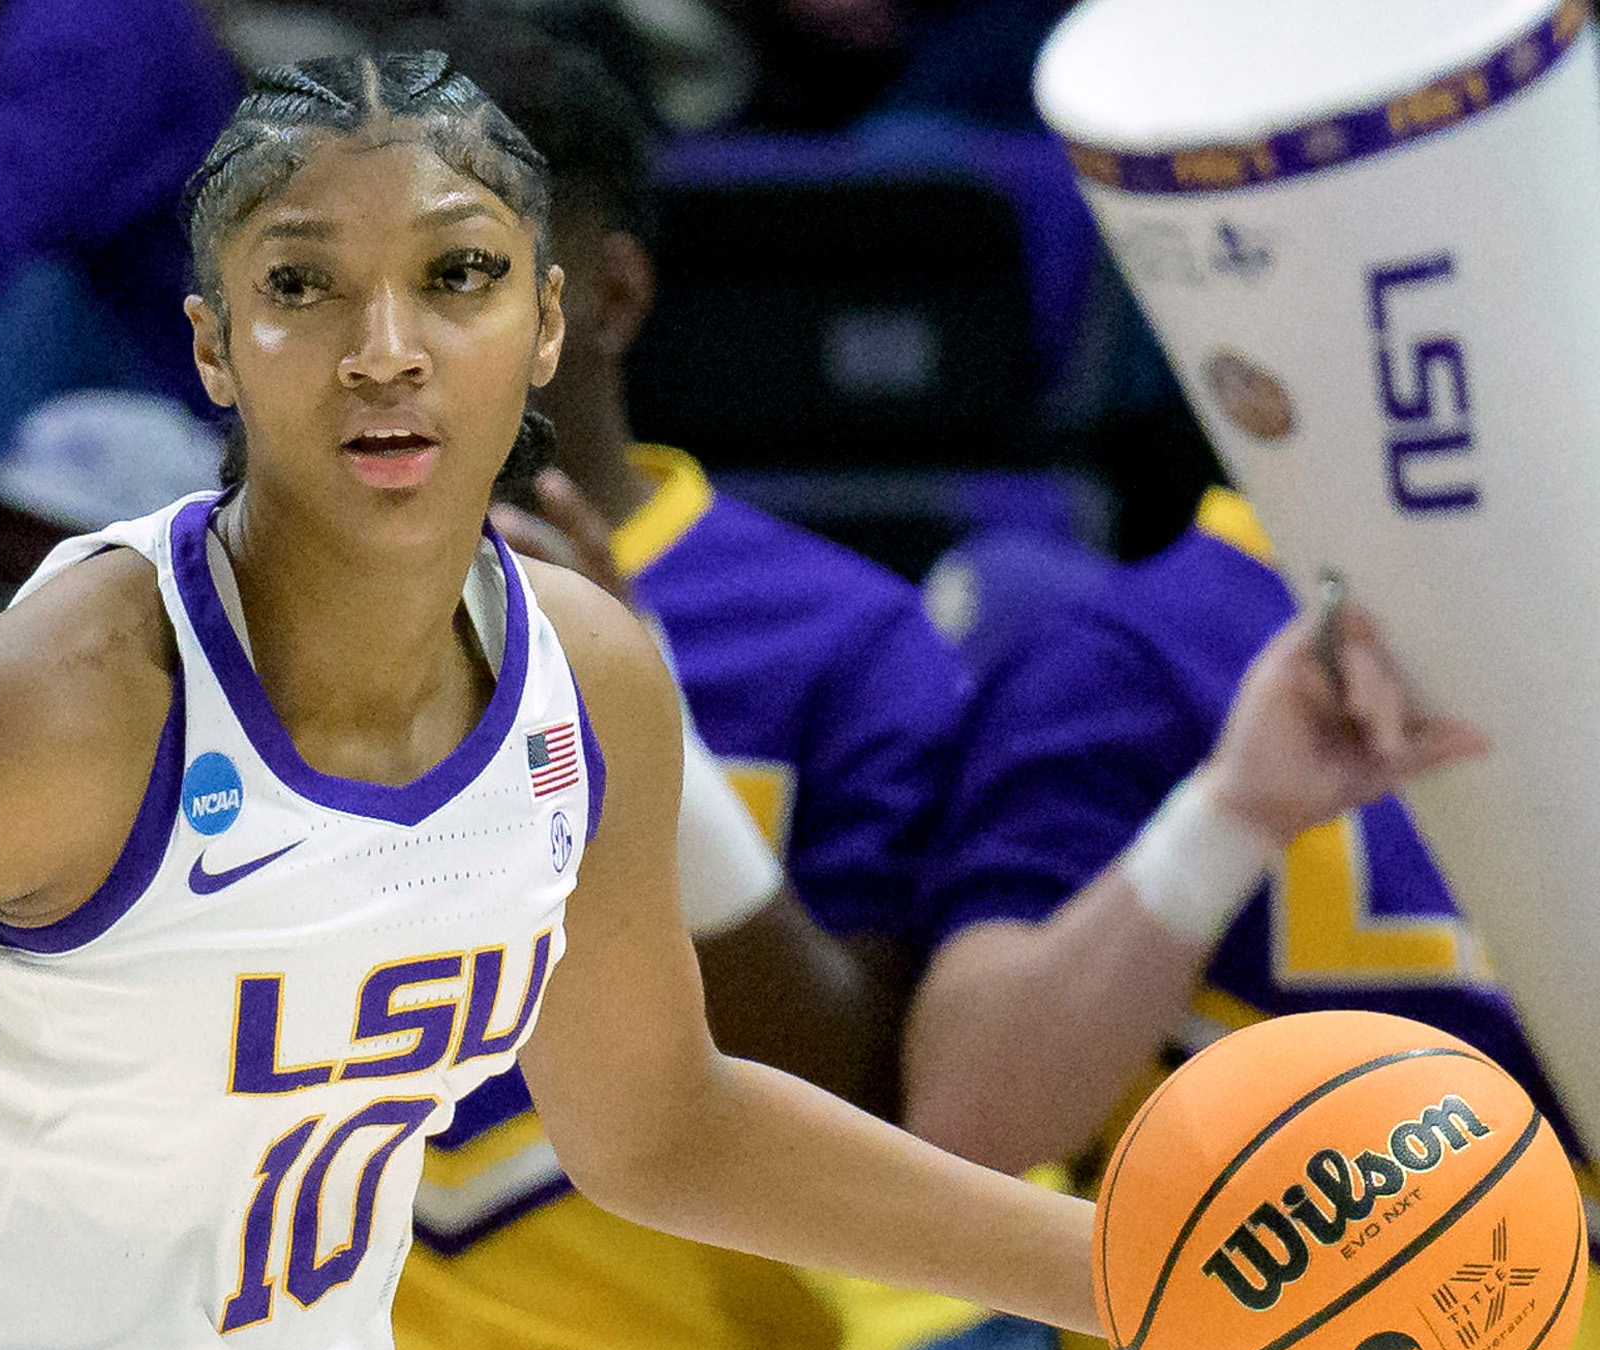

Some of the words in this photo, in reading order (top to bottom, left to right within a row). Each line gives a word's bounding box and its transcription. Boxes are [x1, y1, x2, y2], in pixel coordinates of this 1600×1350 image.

[1364, 252, 1481, 514] LSU
[191, 788, 240, 818] NCAA
[226, 925, 554, 1097] LSU
[218, 1094, 443, 1335] 10
[1201, 1093, 1492, 1312] Wilson
[1339, 1223, 1381, 1261] EVO
[1382, 1187, 1423, 1224] NXT
[1446, 1267, 1507, 1325] TITLE
